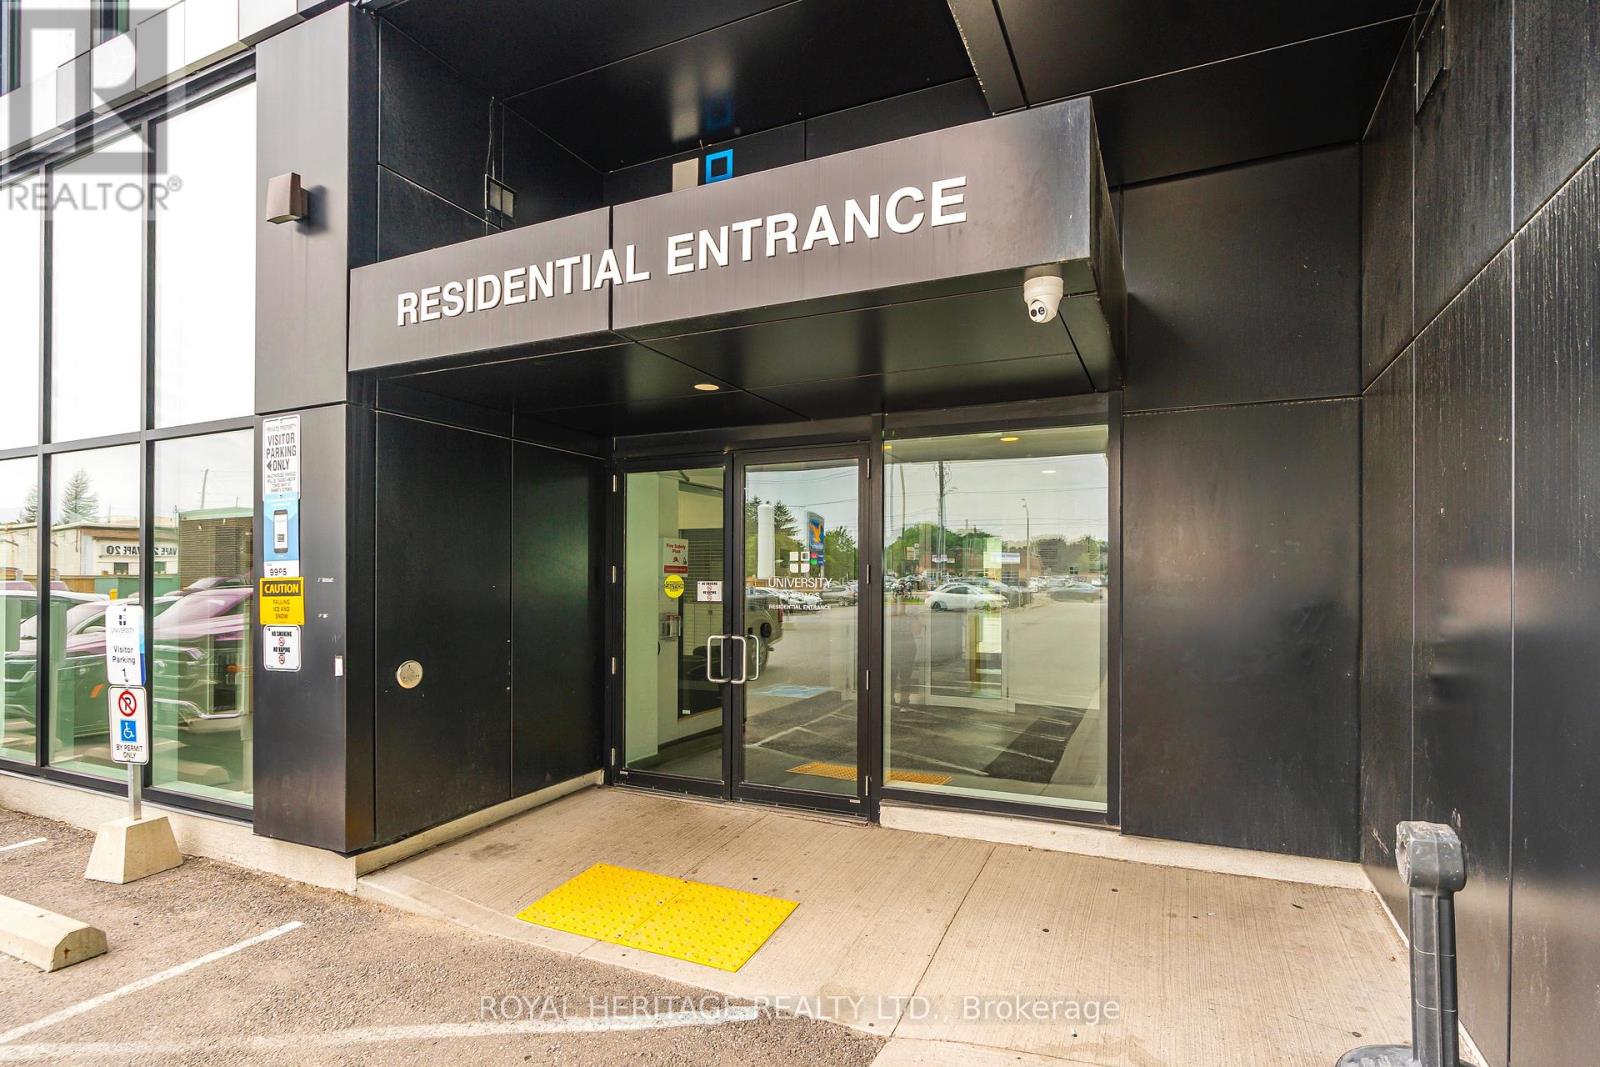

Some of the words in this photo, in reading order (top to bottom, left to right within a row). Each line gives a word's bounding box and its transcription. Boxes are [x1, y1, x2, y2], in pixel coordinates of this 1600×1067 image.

[396, 243, 651, 328] RESIDENTIAL
[666, 175, 968, 277] ENTRANCE
[267, 432, 295, 447] VISITOR
[266, 445, 297, 459] PARKING
[272, 459, 290, 471] ONLY
[768, 578, 833, 588] UNIVERSITY
[264, 583, 299, 594] CAUTION
[113, 646, 133, 654] Visitor
[112, 655, 136, 665] Parking
[123, 744, 143, 752] PERMIT
[123, 751, 136, 759] ONLY
